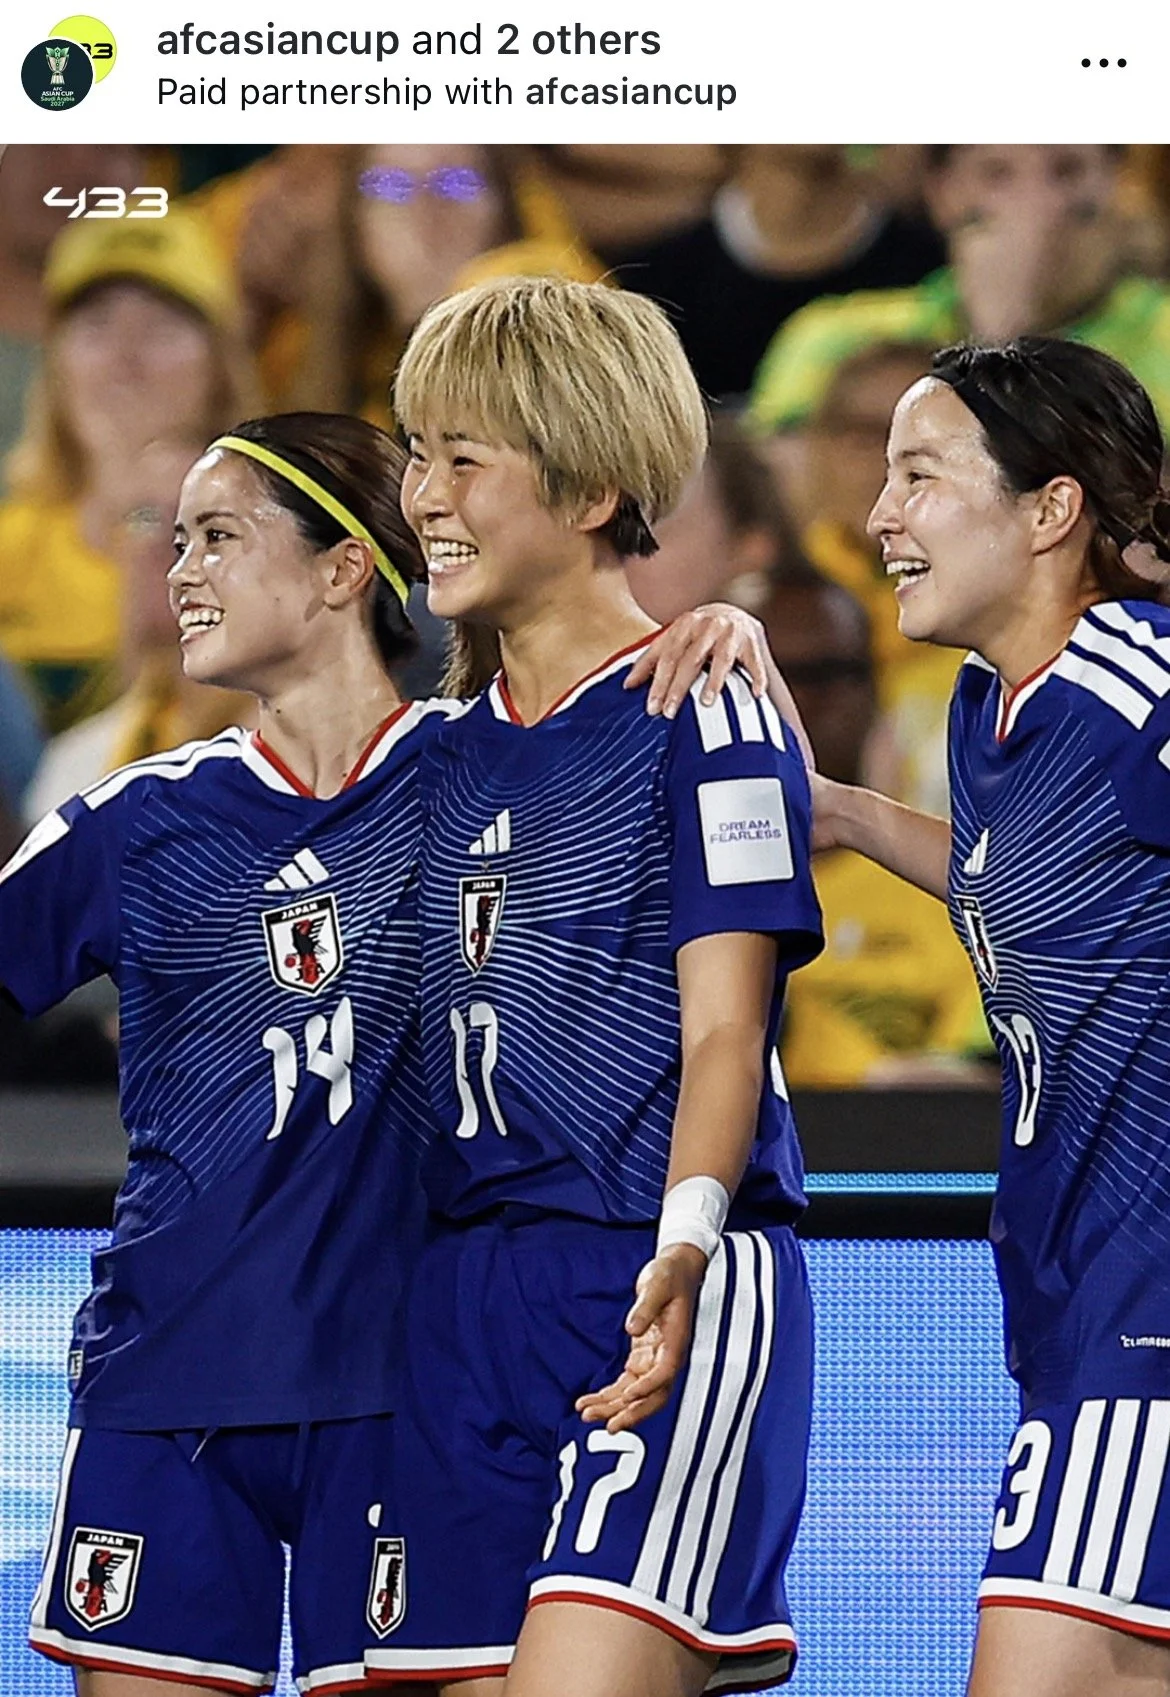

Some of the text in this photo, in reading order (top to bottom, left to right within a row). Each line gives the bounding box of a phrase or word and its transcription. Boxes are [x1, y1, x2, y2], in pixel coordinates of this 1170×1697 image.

[719, 819, 771, 832] DREAM
[710, 829, 782, 844] FEARLESS
[281, 902, 319, 920] JAPAN
[262, 996, 355, 1141] 14
[450, 1002, 508, 1139] 17
[543, 1429, 646, 1562] 17
[87, 1533, 125, 1547] JAPAN
